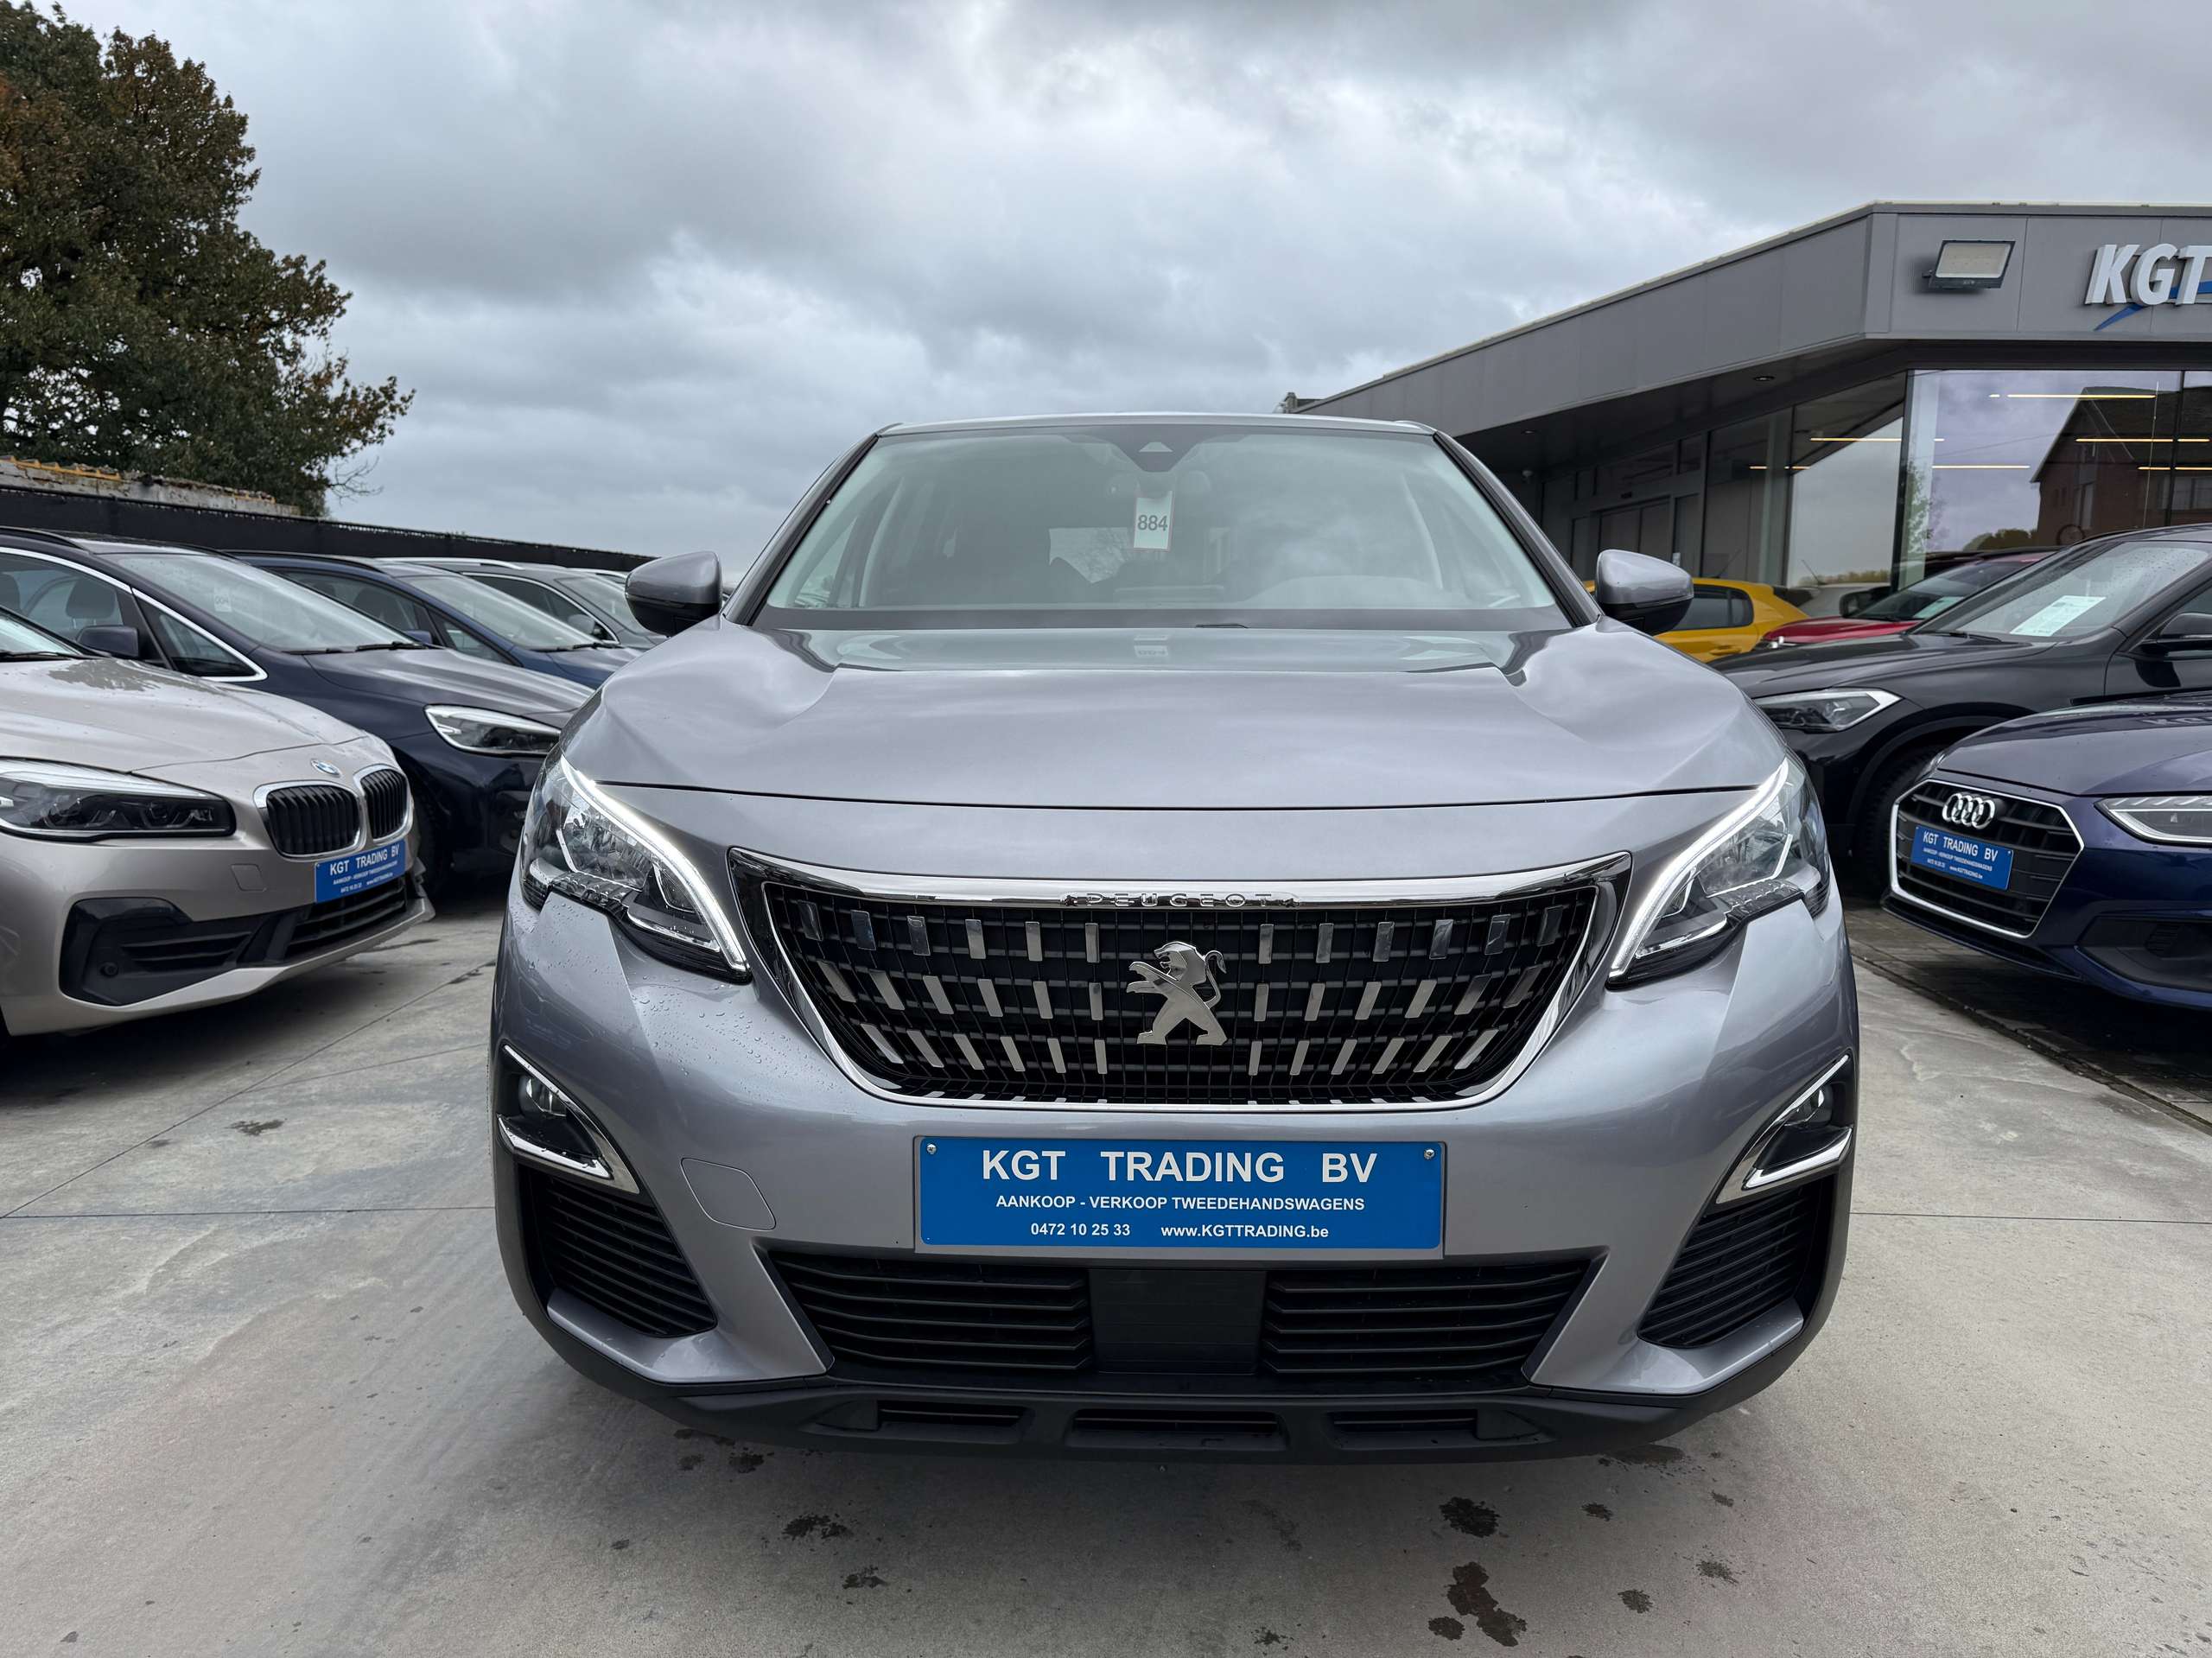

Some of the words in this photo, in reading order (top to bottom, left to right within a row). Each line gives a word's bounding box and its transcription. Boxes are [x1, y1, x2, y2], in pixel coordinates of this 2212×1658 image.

[2085, 243, 2212, 306] KGT
[1137, 514, 1168, 531] 884
[1923, 831, 1938, 845] KGT
[1943, 836, 1979, 856] TRADING
[1984, 848, 1998, 861] BV
[330, 860, 349, 876] KGT
[356, 849, 387, 868] TRADING
[391, 844, 399, 857] BV
[1086, 893, 1272, 907] PEUGEOT
[982, 1150, 1065, 1180] KGT
[1101, 1151, 1284, 1183] TRADING
[1322, 1153, 1377, 1183] BV
[995, 1195, 1076, 1208] AANKOOP
[1089, 1196, 1167, 1209] VERKOOP
[1172, 1197, 1365, 1210] TWEEDEHANDSWAGENS
[1031, 1223, 1065, 1236] 0472
[1071, 1223, 1087, 1236] 10
[1091, 1223, 1109, 1236] 25
[1113, 1223, 1130, 1236] 33
[1160, 1224, 1329, 1238] www.KGTTRADING.be
